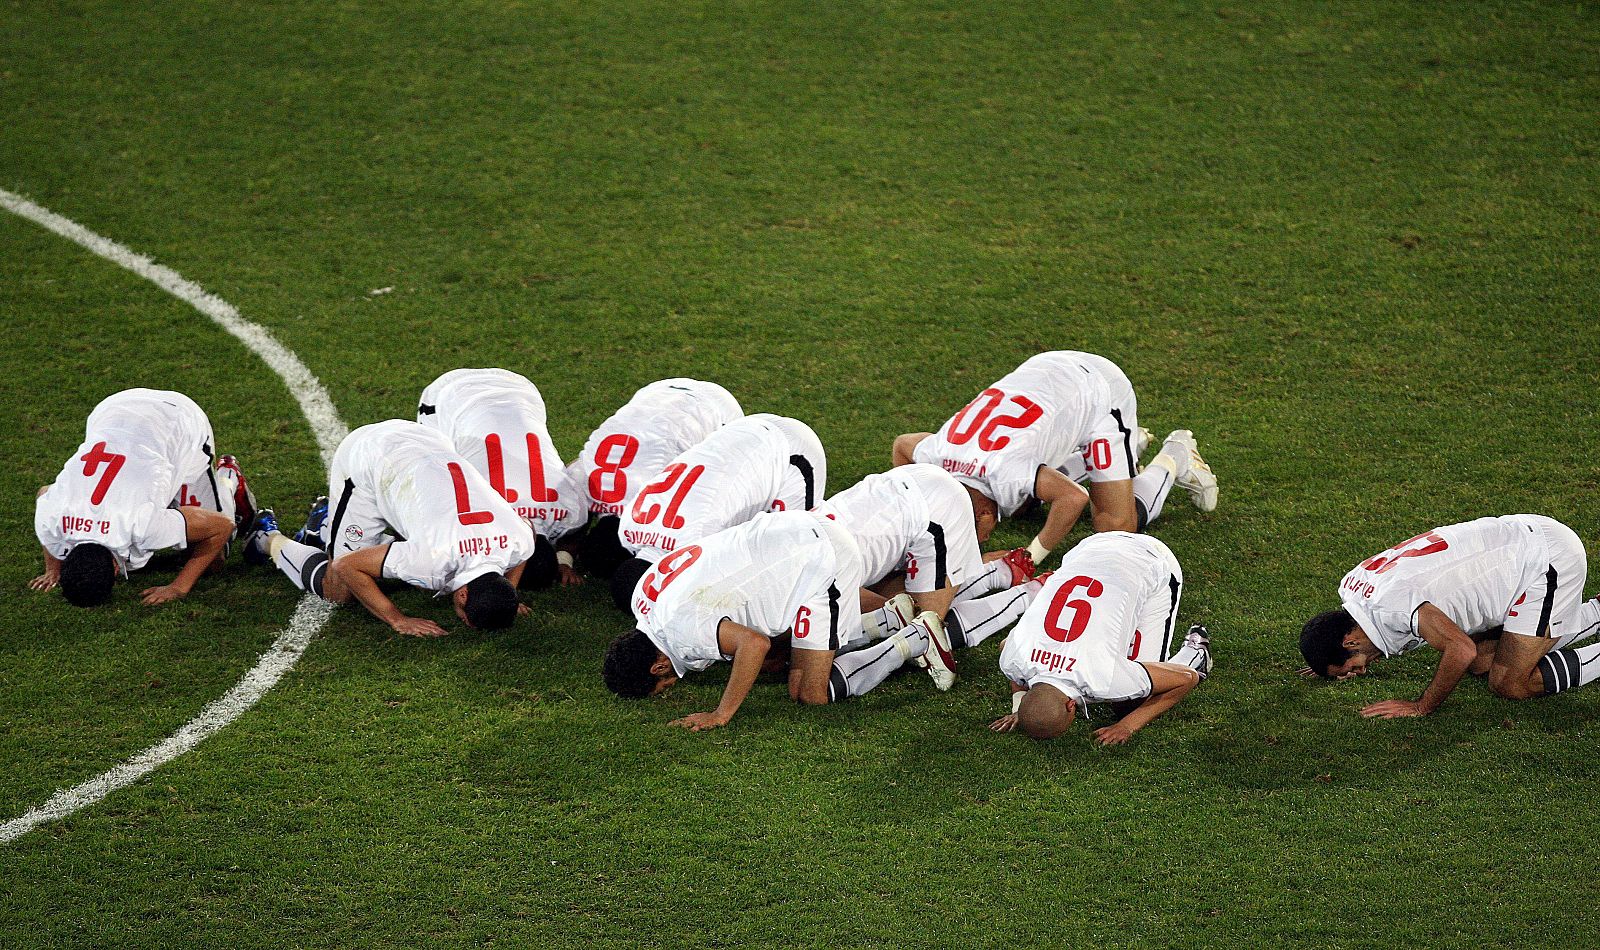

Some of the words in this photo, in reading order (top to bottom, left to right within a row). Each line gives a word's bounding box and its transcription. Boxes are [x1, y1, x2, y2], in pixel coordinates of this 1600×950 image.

[947, 387, 1044, 452] 20
[81, 441, 127, 506] 4
[455, 461, 495, 526] 7
[485, 432, 560, 503] 11
[588, 433, 640, 503] 8
[631, 463, 705, 530] 12
[62, 515, 94, 536] said
[459, 536, 492, 558] fathi
[642, 545, 704, 603] 6
[793, 606, 812, 639] 6
[1043, 575, 1104, 643] 9
[1030, 648, 1078, 674] zidan
